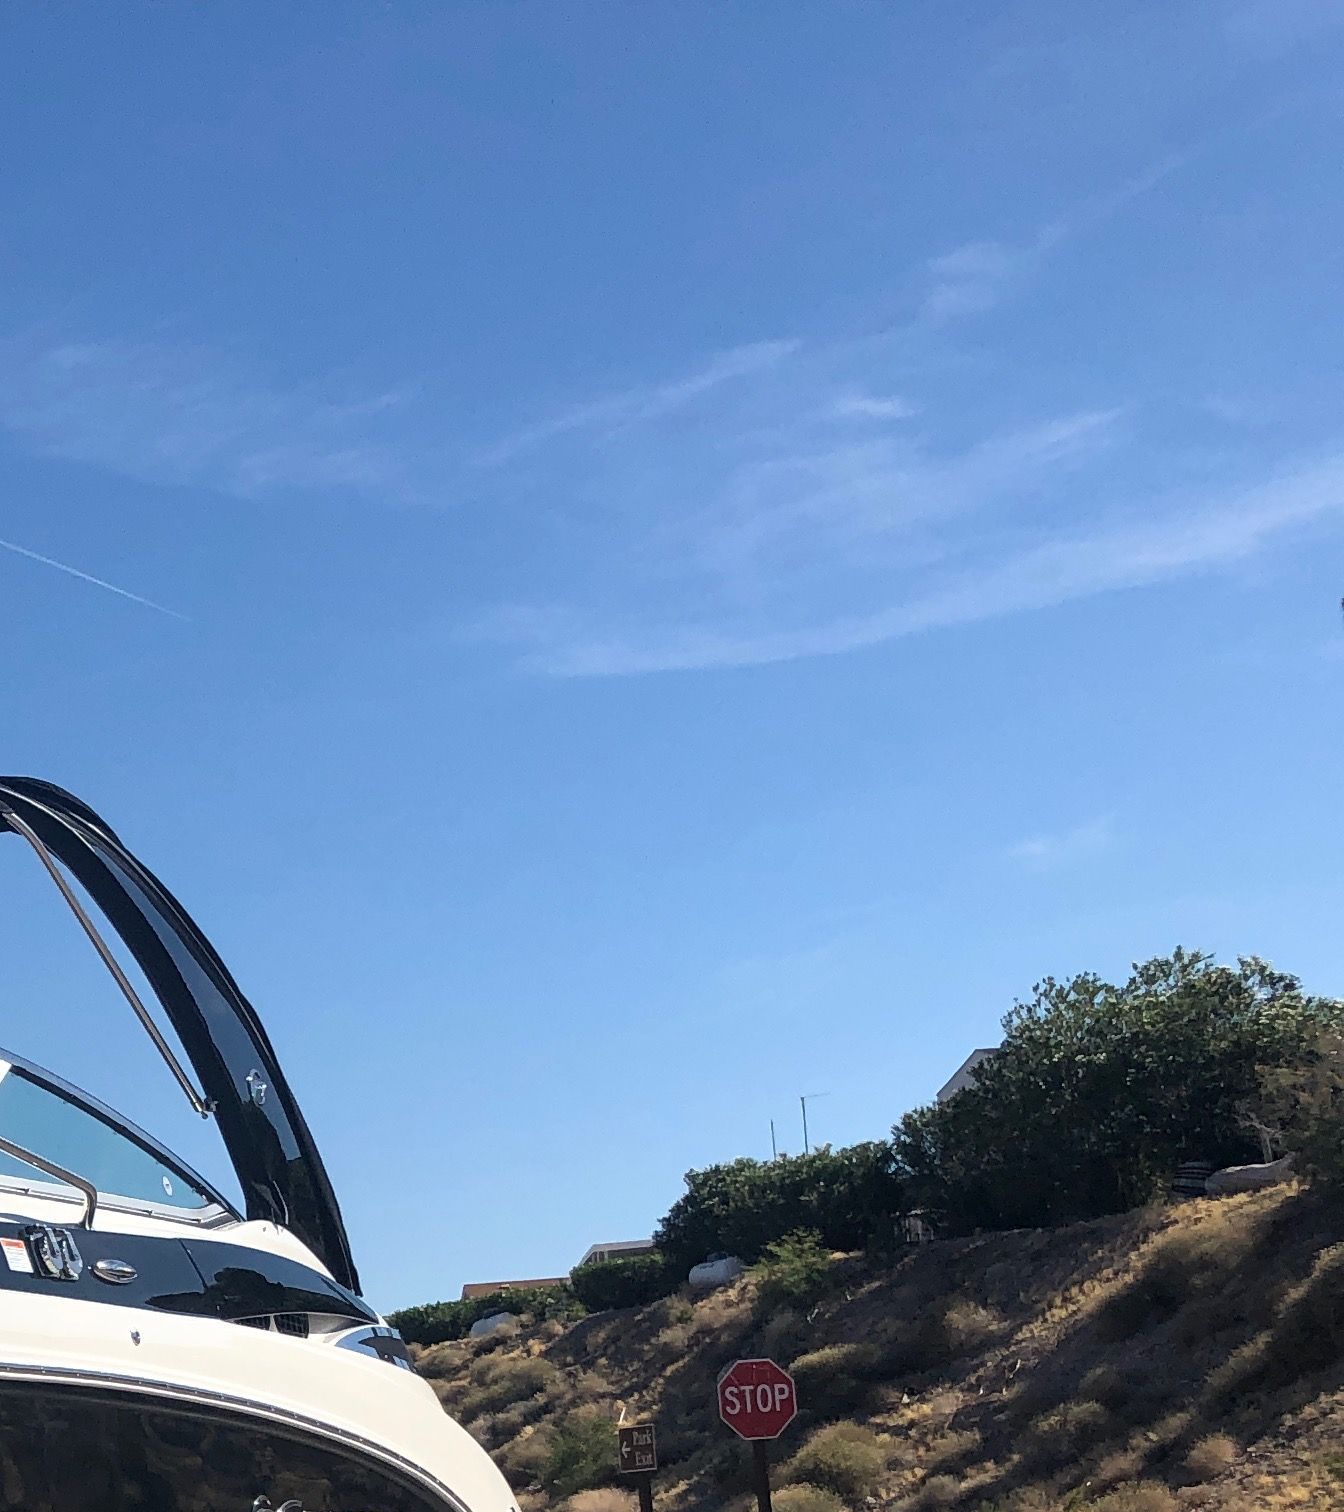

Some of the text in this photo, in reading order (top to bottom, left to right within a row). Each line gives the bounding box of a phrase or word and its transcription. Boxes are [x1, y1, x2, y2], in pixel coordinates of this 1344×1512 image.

[725, 1384, 789, 1414] STOP
[632, 1429, 653, 1446] Park
[634, 1451, 653, 1466] Exit
